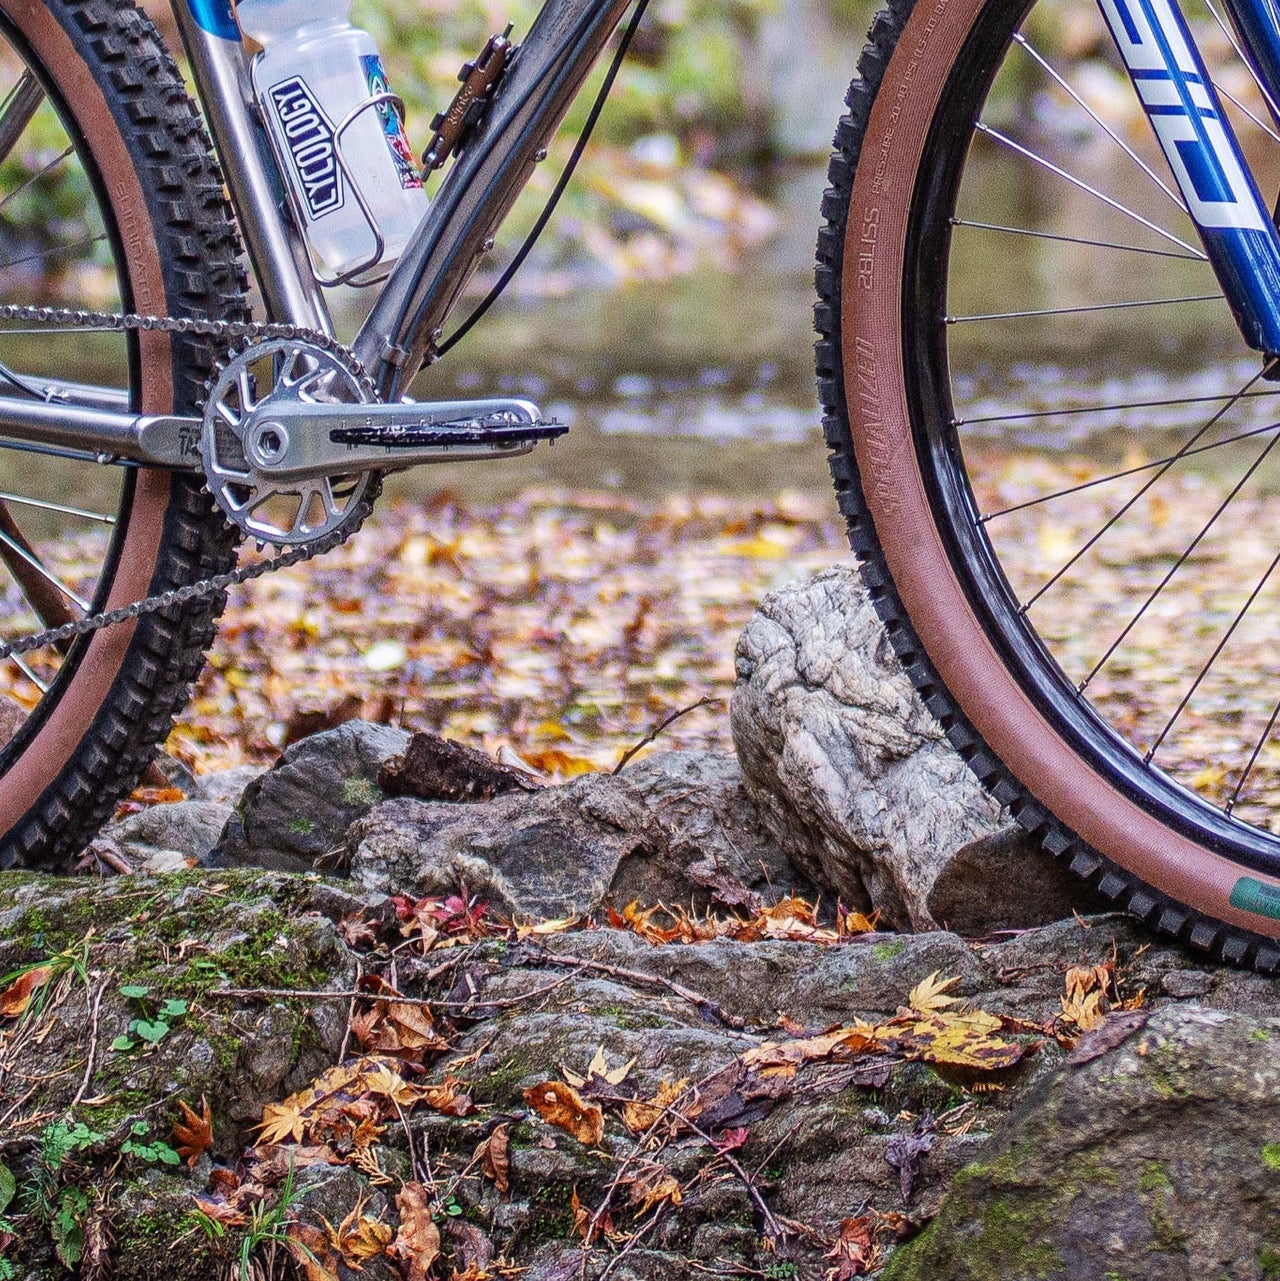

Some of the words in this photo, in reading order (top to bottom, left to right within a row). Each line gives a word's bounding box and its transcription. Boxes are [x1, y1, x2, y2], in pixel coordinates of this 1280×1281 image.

[275, 91, 336, 210] CYCOLOGY
[857, 207, 880, 290] 2BLISS
[855, 337, 899, 513] SPECIALIZED
